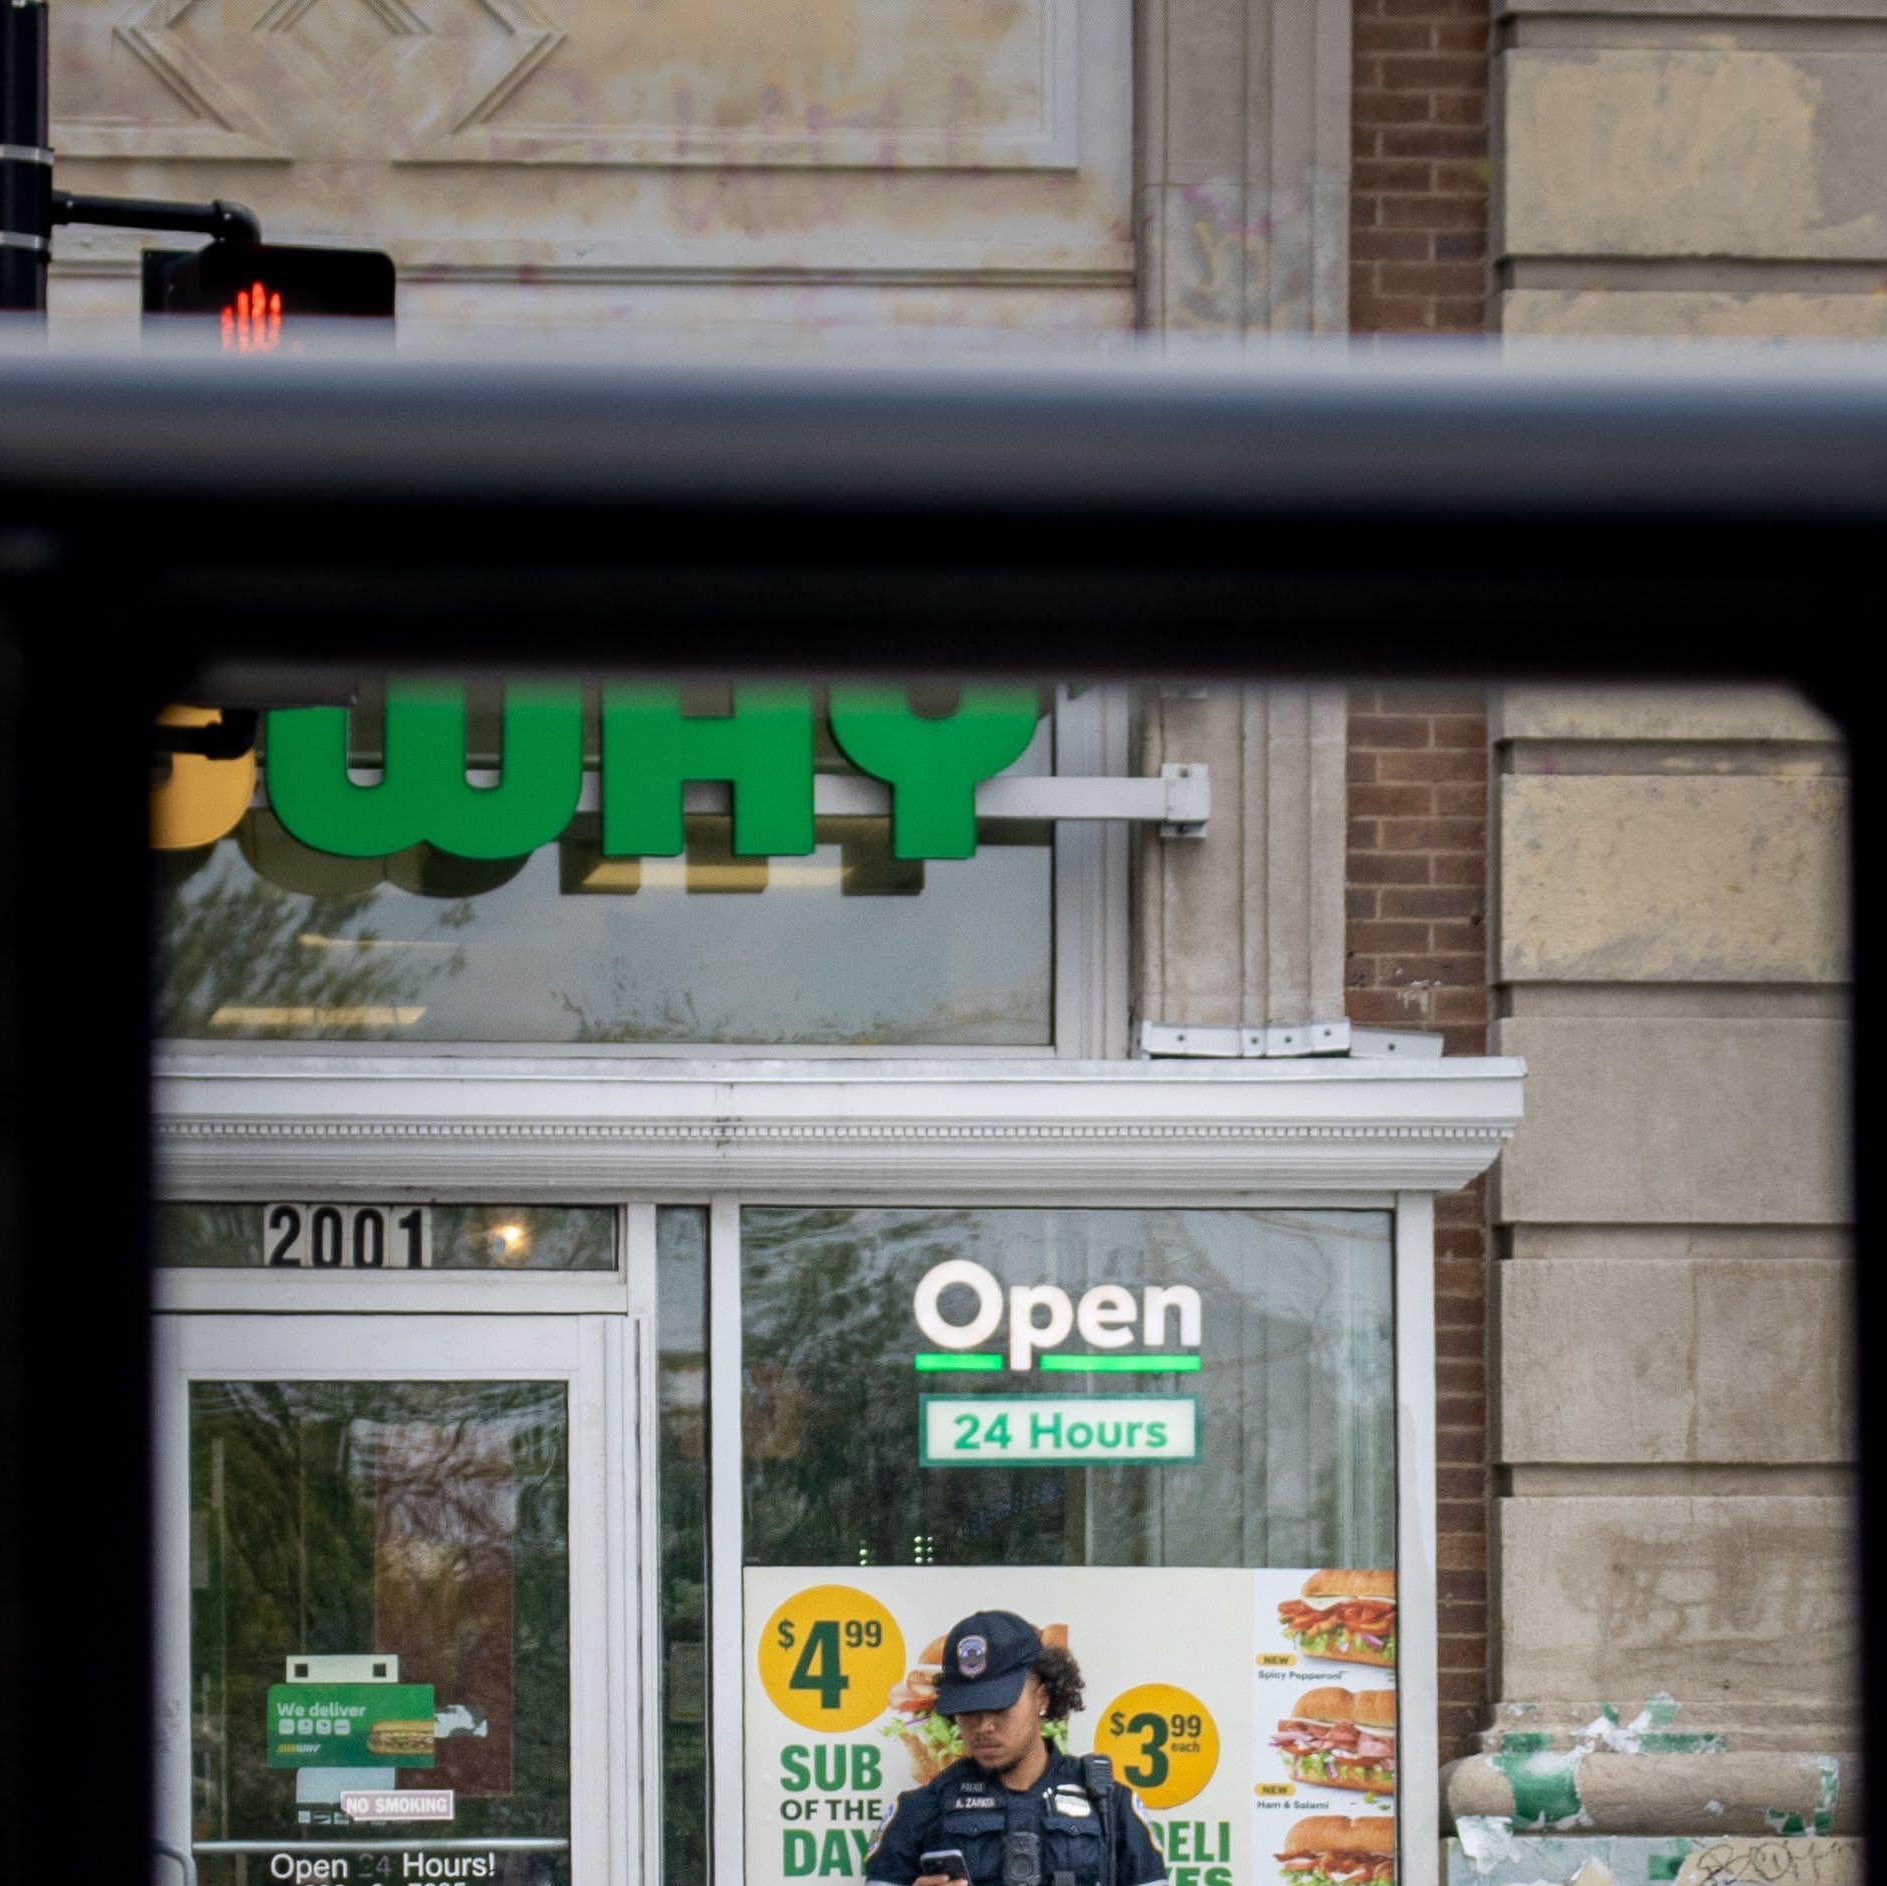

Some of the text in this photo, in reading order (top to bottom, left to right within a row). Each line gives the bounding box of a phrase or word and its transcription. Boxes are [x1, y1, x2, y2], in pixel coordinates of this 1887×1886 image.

[270, 1205, 422, 1268] 2001
[914, 1260, 1201, 1371] Open
[954, 1412, 1168, 1449] 24 Hours
[1264, 1655, 1289, 1664] NEW
[1258, 1670, 1342, 1680] Spicy Pepperoni
[277, 1702, 366, 1718] We deliver
[1171, 1740, 1200, 1753] each
[780, 1744, 883, 1792] SUB
[1263, 1786, 1288, 1794] NEW
[346, 1798, 448, 1813] NO SMOKING
[780, 1799, 883, 1821] OF THE
[1257, 1801, 1281, 1809] Ham
[1294, 1801, 1329, 1809] Salami
[271, 1853, 349, 1884] Open
[402, 1852, 496, 1877] Hours!
